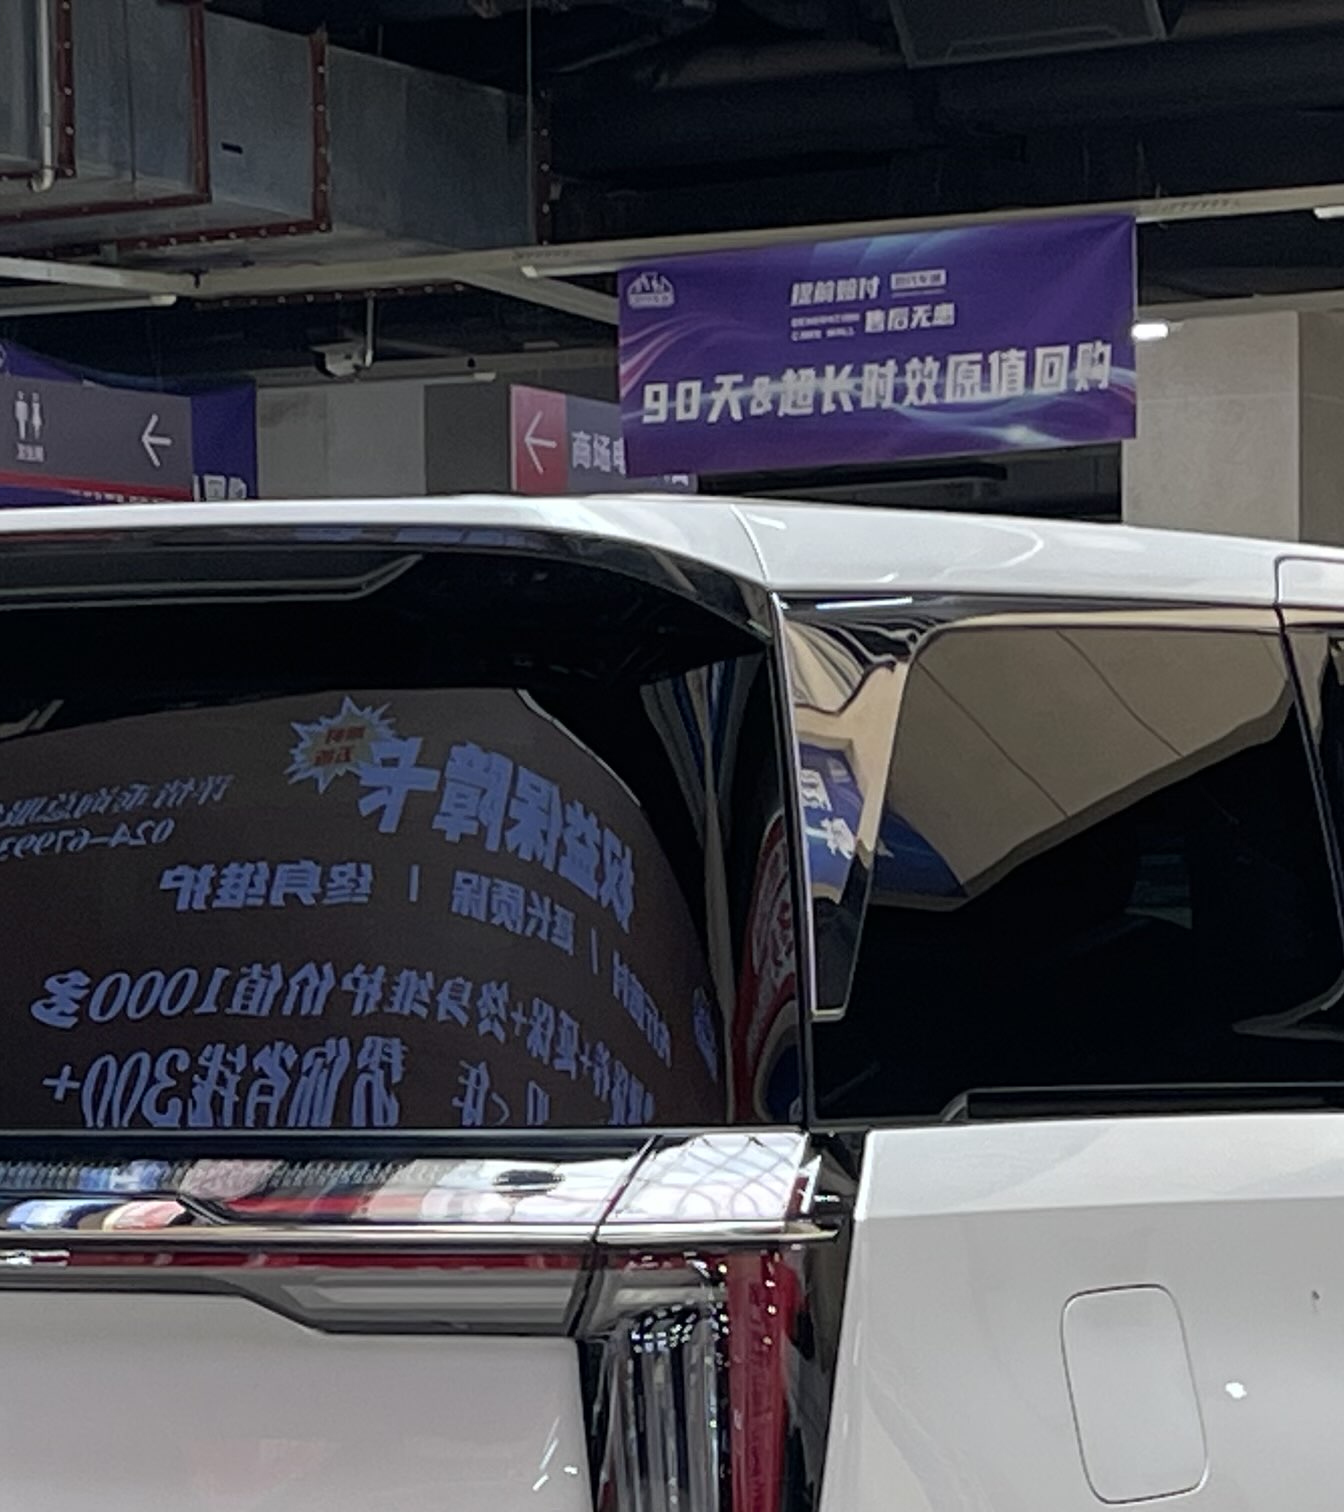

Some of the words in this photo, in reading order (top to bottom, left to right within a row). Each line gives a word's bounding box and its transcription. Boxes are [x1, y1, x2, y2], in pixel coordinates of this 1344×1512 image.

[641, 340, 1113, 425] 90天&超长时效原值回购
